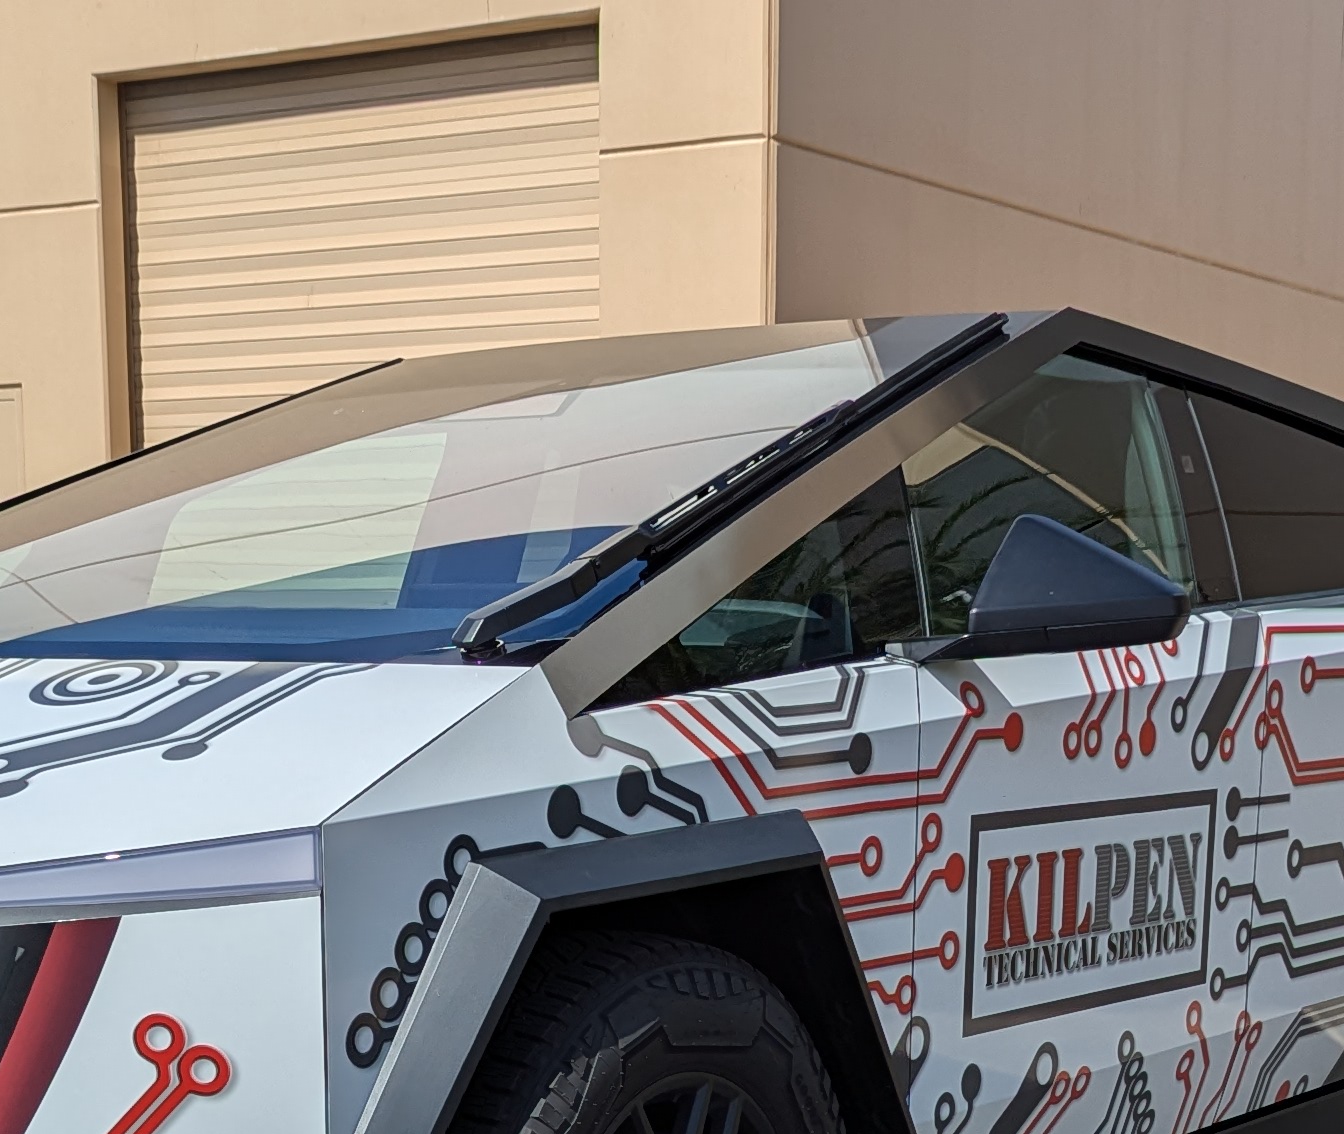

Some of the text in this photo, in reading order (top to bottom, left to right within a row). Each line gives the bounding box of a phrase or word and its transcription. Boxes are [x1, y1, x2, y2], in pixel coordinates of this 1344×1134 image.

[984, 832, 1202, 952] KILPEN
[983, 918, 1197, 988] TECHNICAL SERVICES
